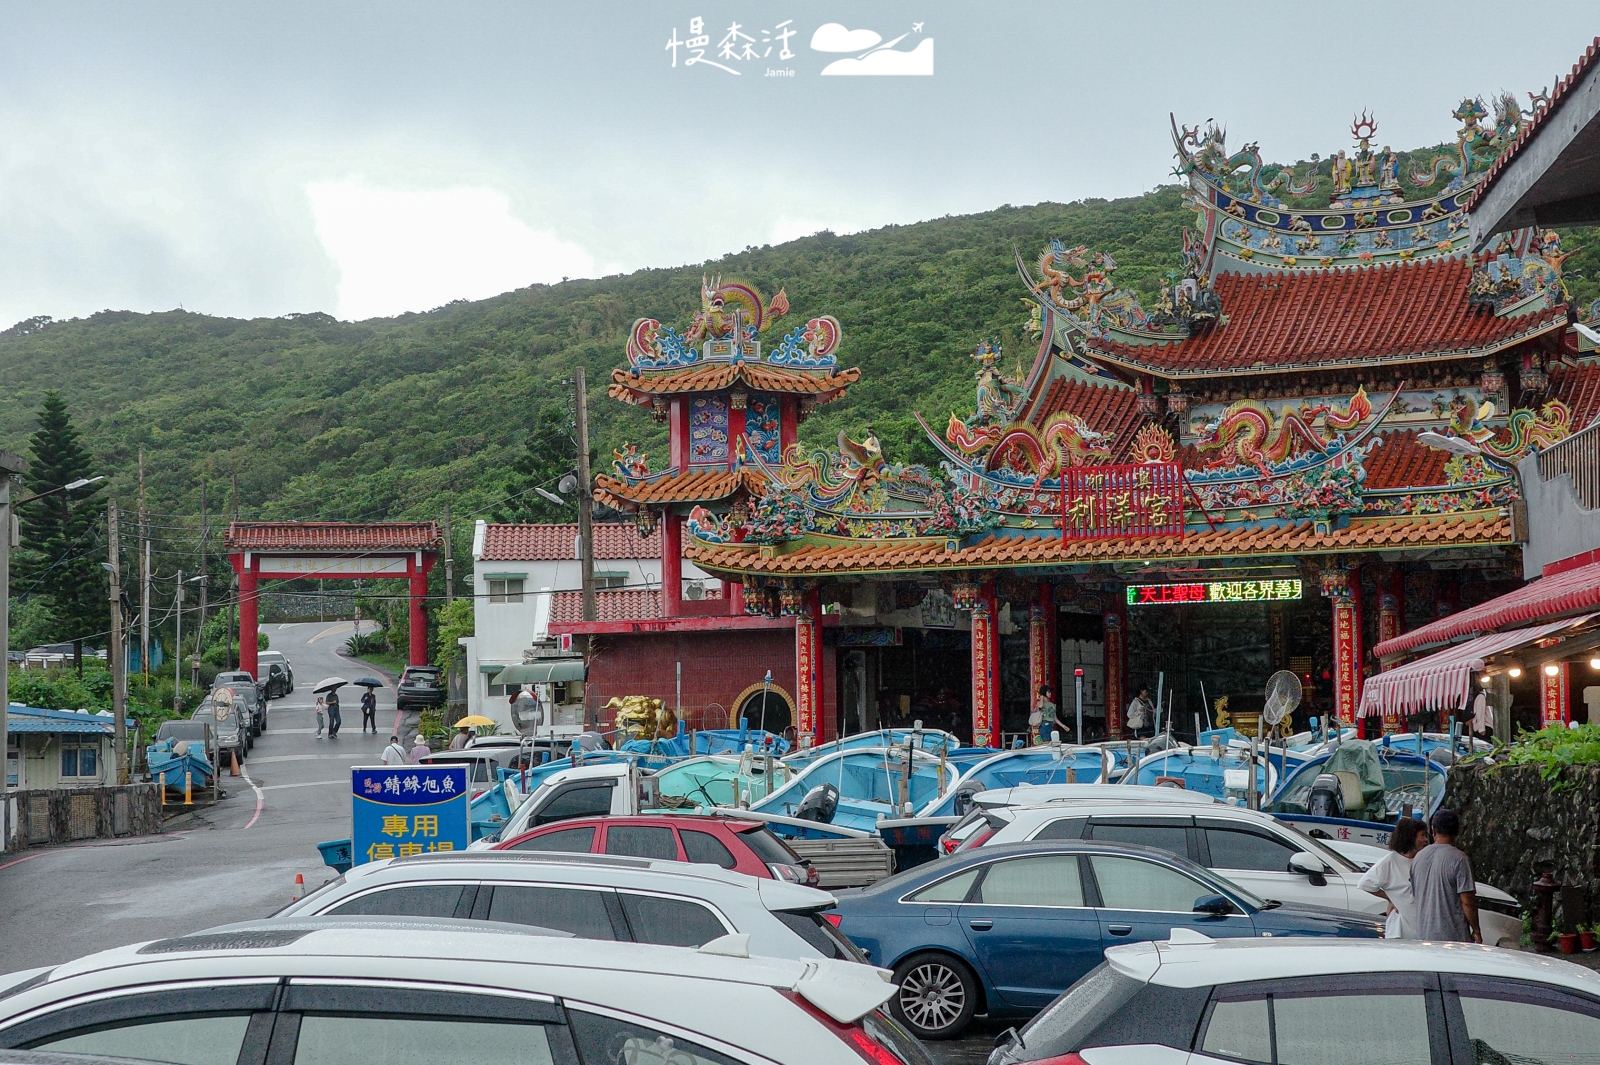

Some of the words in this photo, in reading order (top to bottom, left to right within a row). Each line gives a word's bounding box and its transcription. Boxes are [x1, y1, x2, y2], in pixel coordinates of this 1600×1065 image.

[1069, 491, 1171, 531] 利洋宮
[1139, 584, 1206, 604] 天上聖母
[381, 814, 438, 838] 專用
